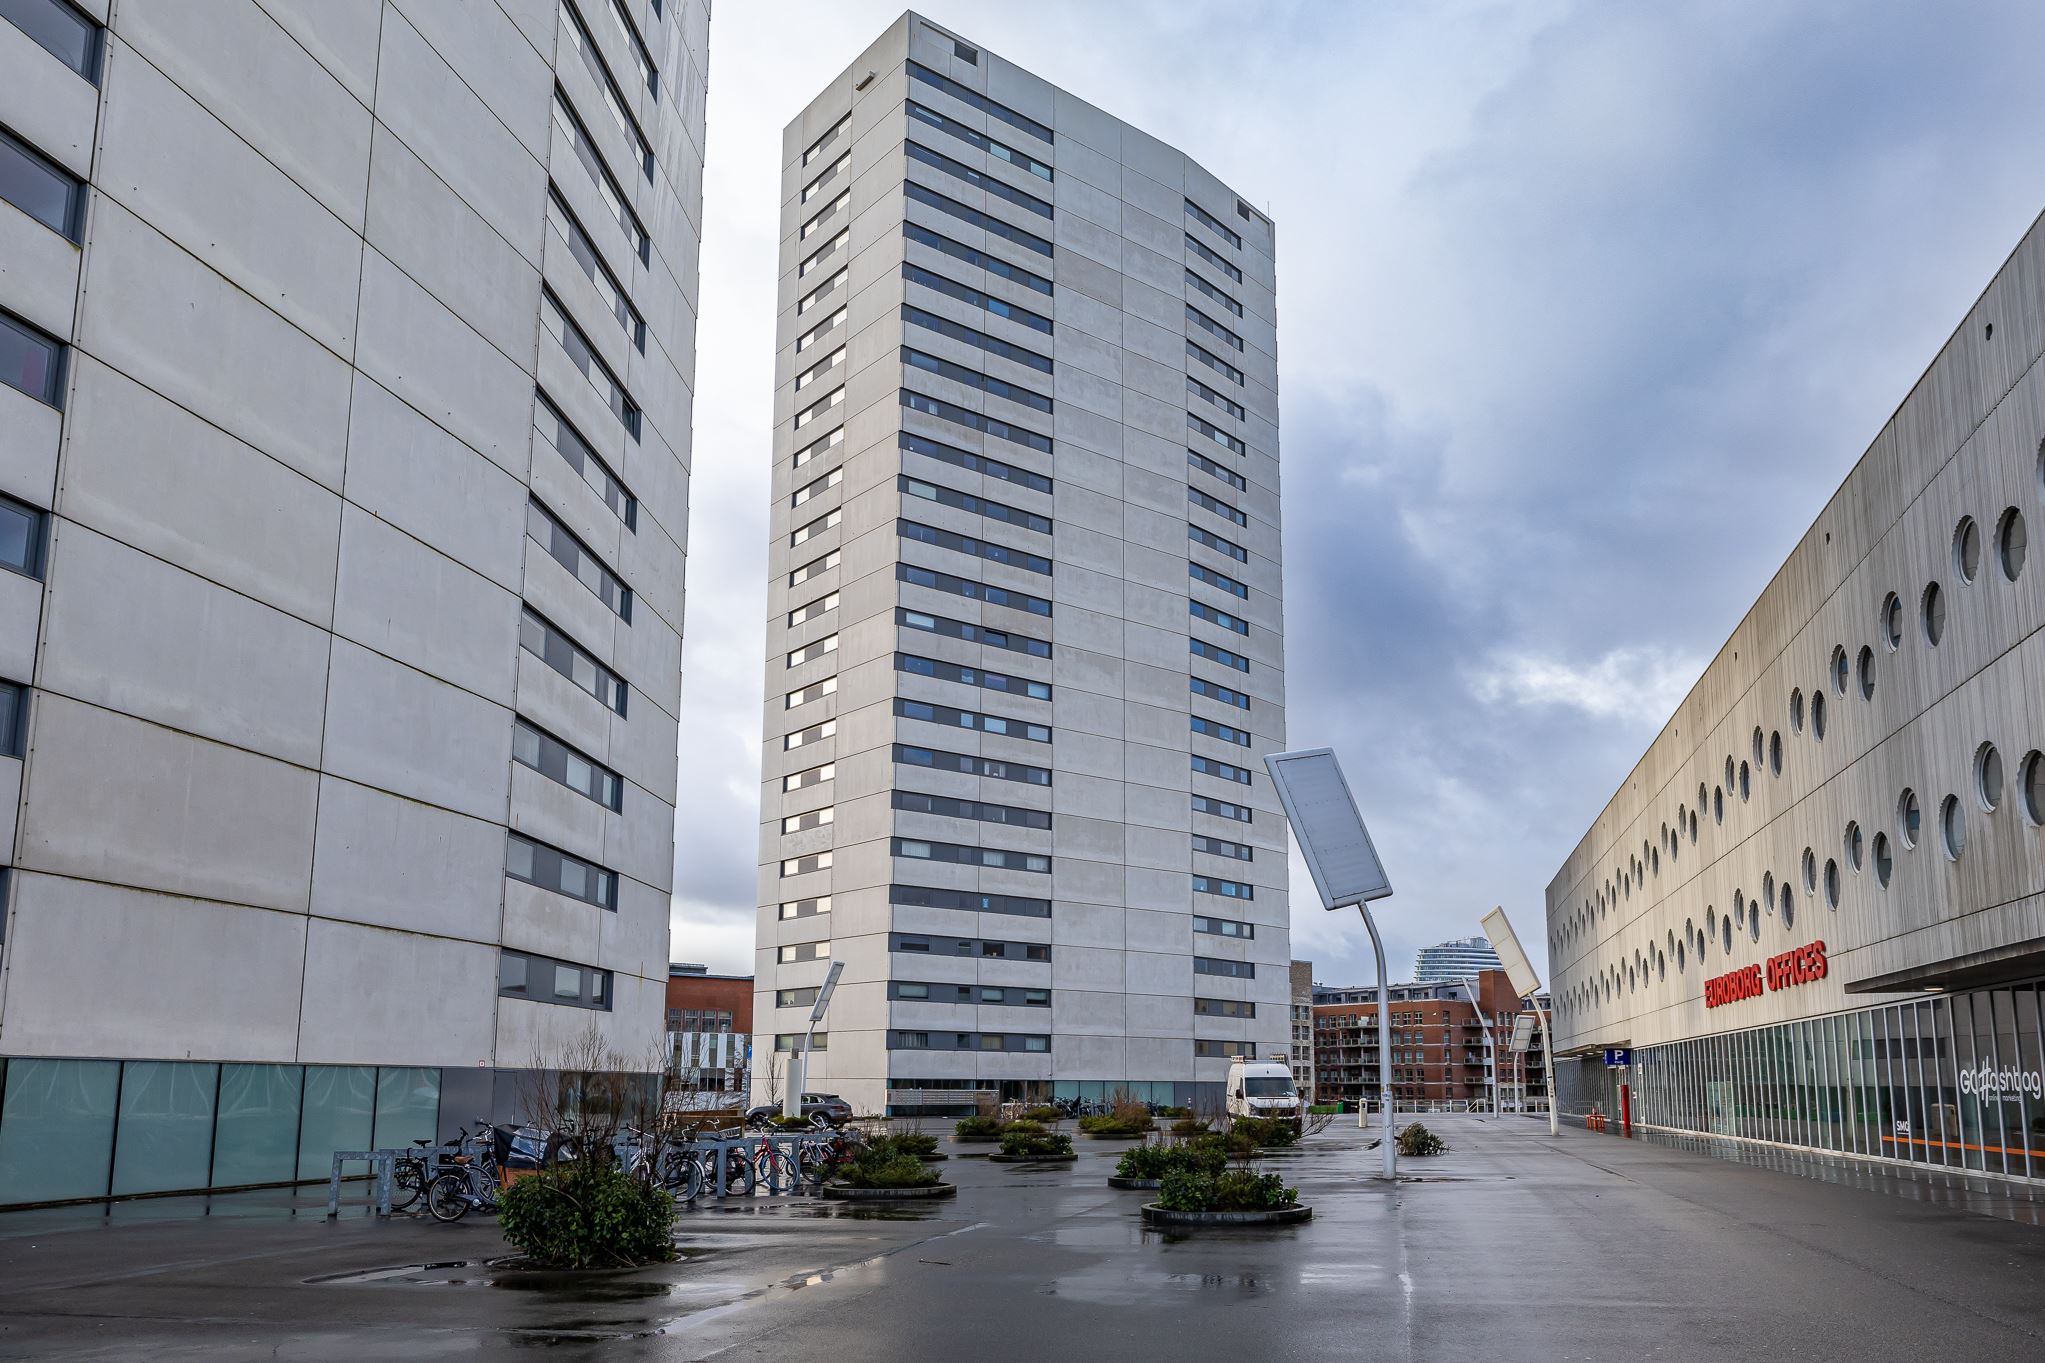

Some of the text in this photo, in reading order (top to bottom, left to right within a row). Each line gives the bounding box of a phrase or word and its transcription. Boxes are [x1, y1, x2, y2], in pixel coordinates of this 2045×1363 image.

[1704, 940, 1827, 1008] EUROBORG OFFICES
[1614, 1050, 1624, 1060] P
